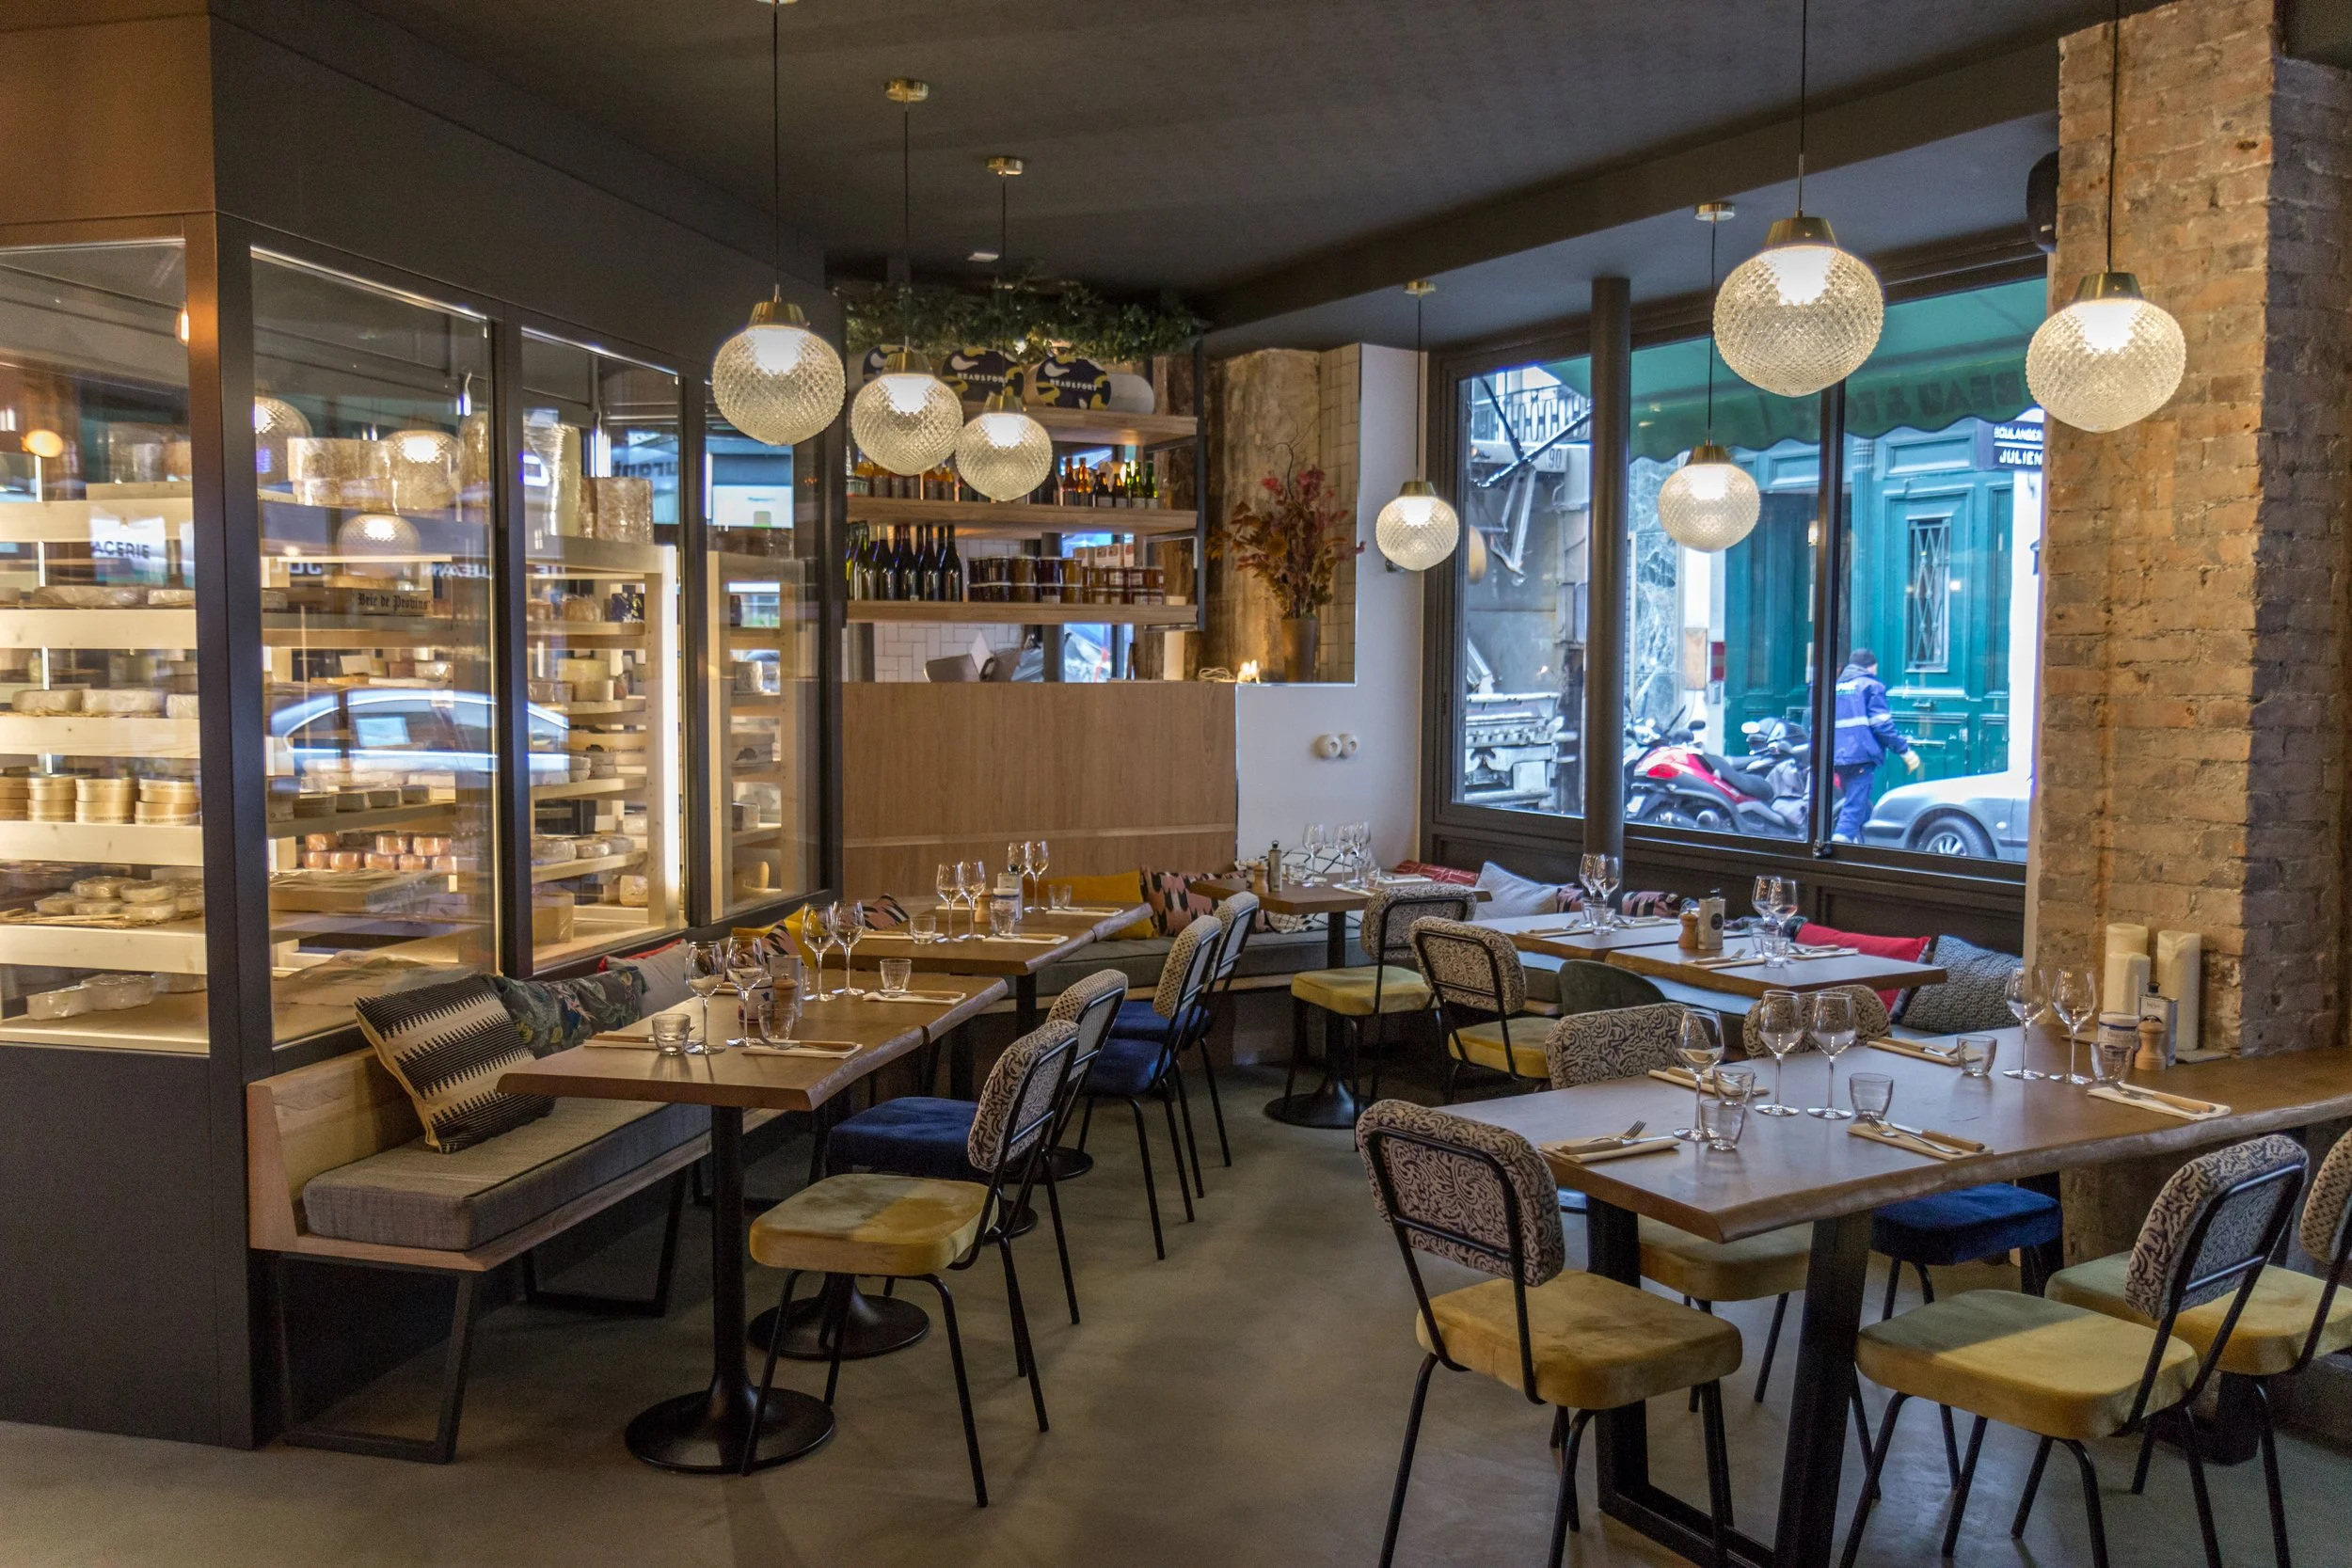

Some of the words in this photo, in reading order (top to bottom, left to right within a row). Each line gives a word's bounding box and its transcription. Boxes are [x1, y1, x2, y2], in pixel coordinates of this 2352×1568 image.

[1548, 448, 1562, 468] 90
[1999, 449, 2042, 466] JULIEN
[358, 593, 377, 606] Brie
[381, 594, 389, 608] de
